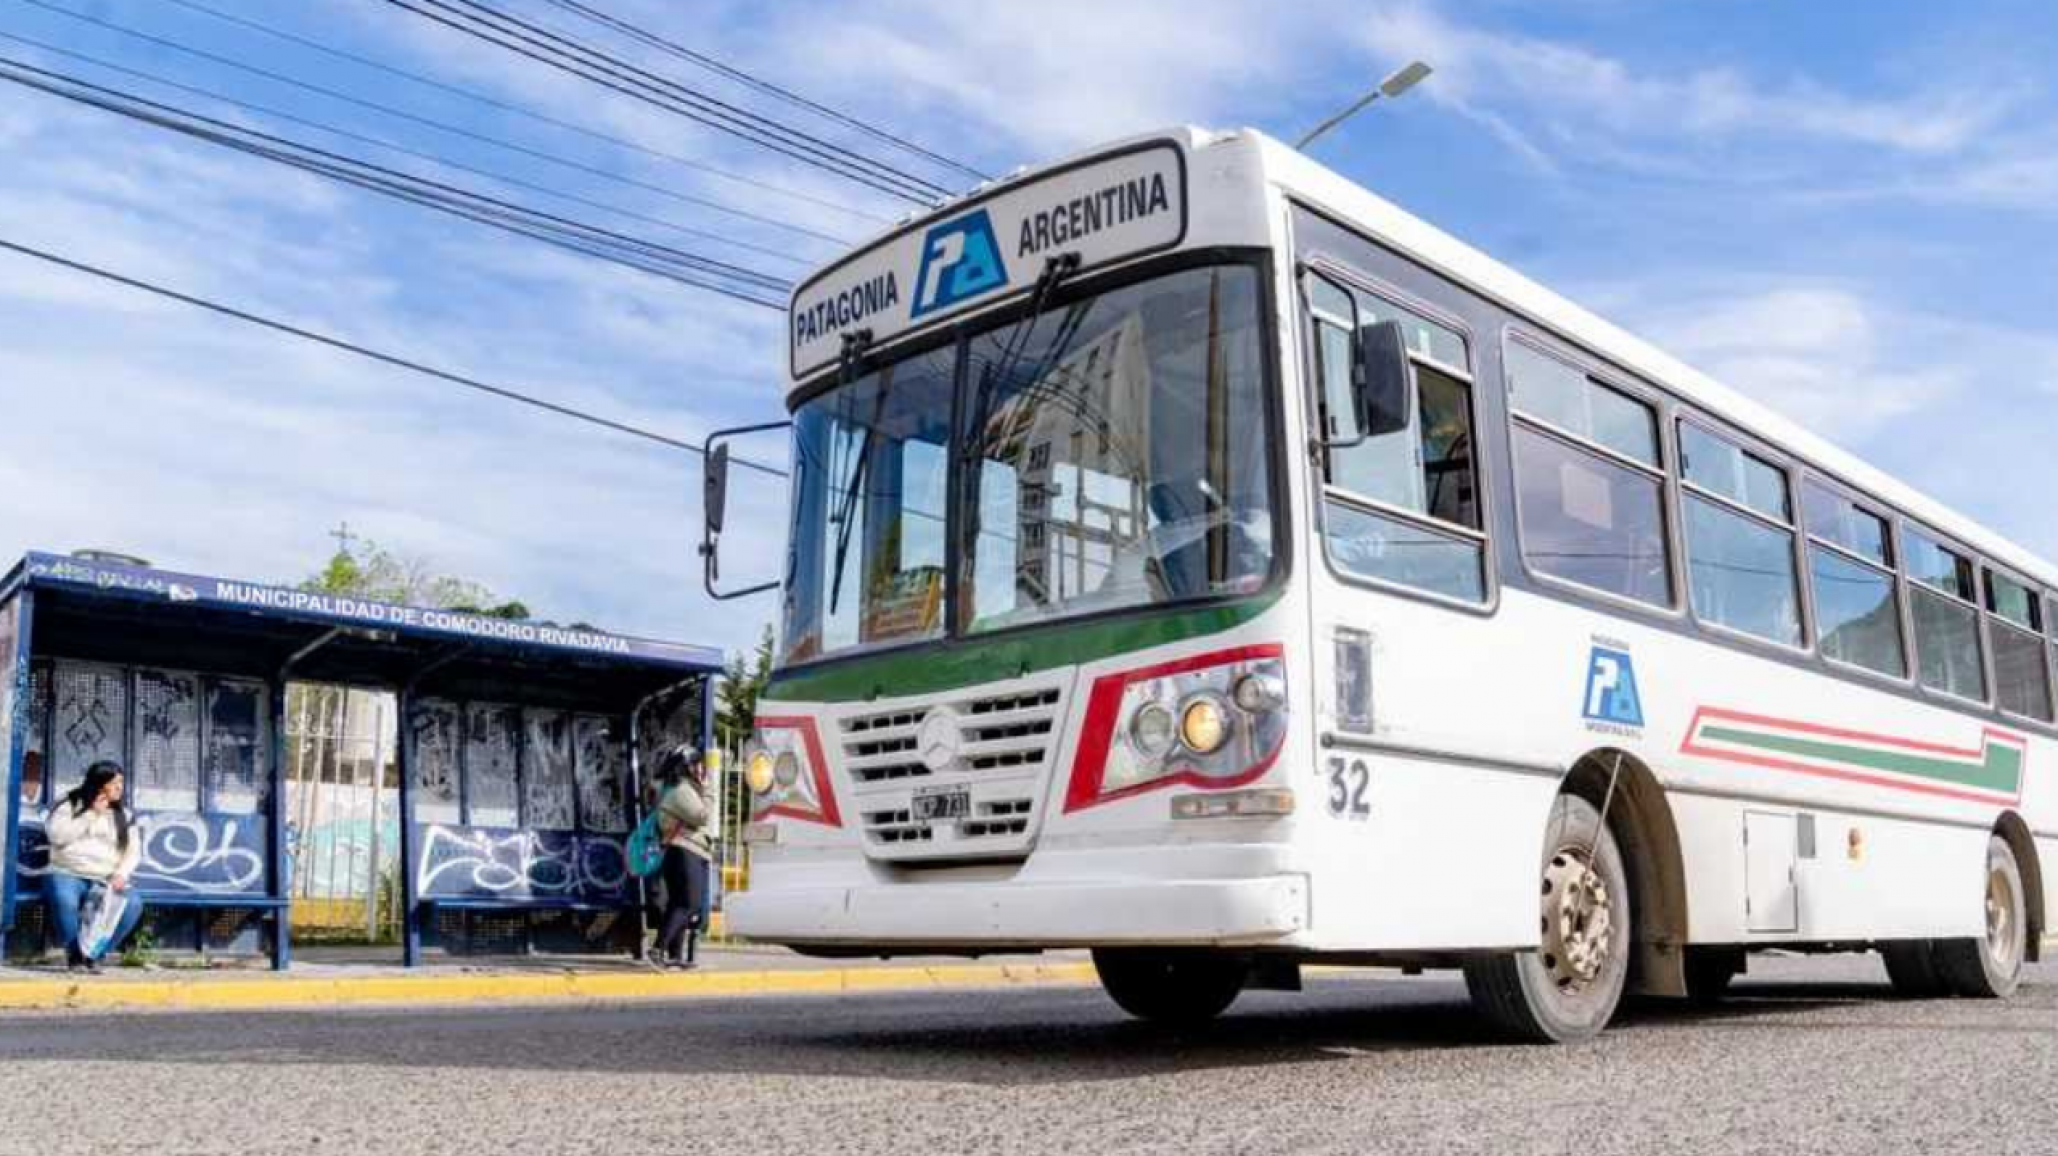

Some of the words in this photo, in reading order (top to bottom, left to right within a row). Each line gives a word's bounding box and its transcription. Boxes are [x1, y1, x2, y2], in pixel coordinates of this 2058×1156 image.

[796, 269, 898, 347] PATAGONIA
[1017, 171, 1169, 259] ARGENTINA
[216, 582, 386, 620] MUNICIPALIDAD
[390, 606, 417, 626] DE
[421, 611, 535, 640] COMODORO
[540, 627, 631, 653] RIVADAVIA
[1328, 757, 1371, 815] 32
